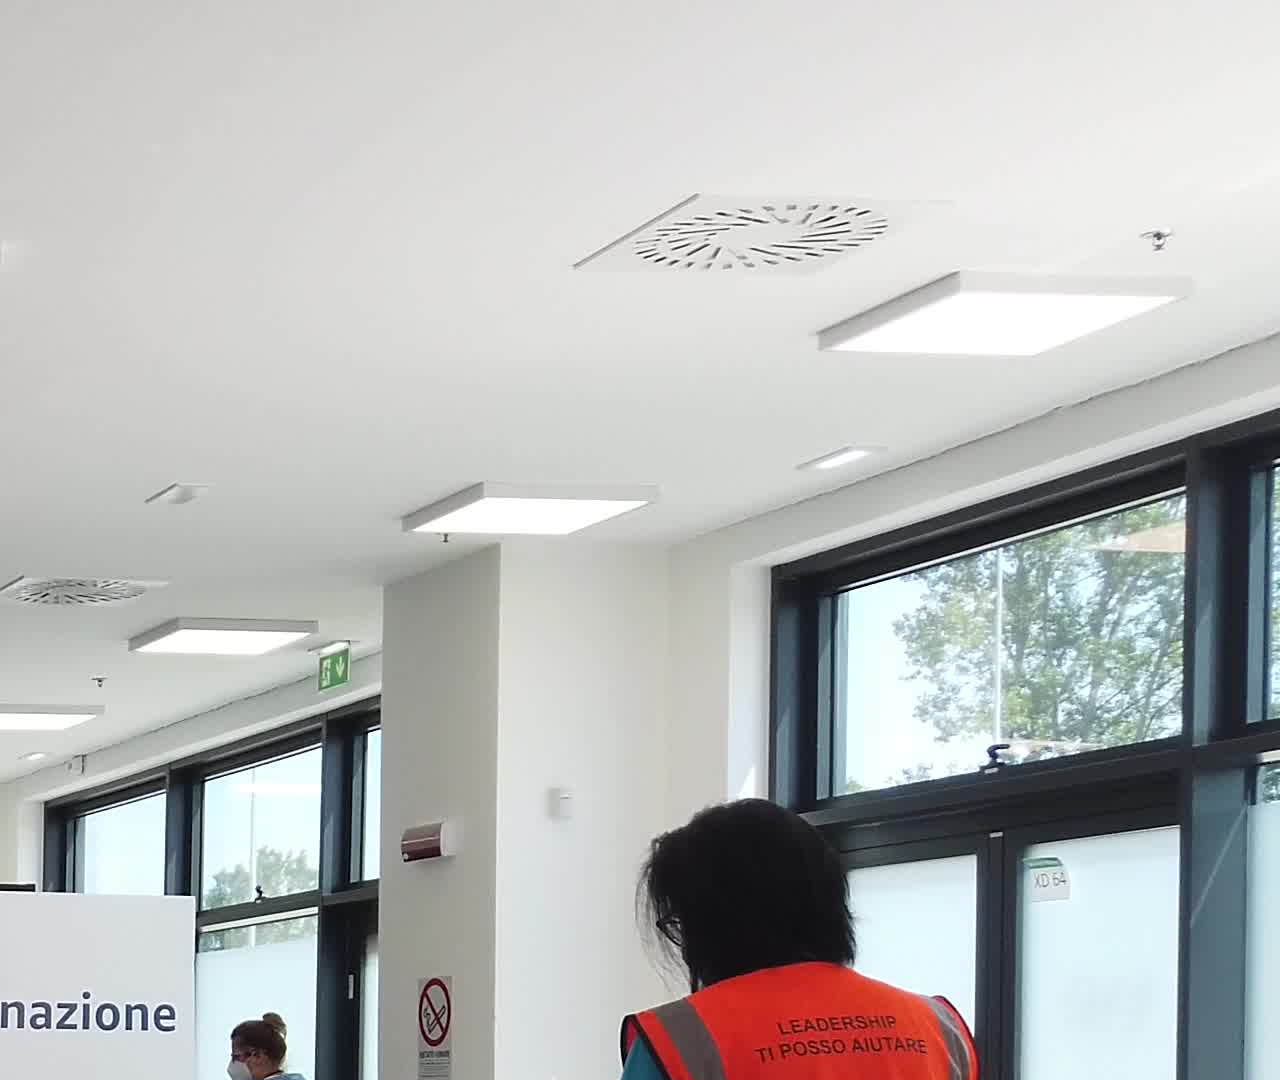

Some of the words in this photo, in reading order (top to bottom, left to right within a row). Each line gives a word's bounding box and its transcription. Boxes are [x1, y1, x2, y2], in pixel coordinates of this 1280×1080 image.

[776, 1015, 897, 1036] LEADERSHIP
[753, 1047, 775, 1064] TI
[780, 1039, 846, 1058] POSSO
[851, 1037, 928, 1055] AIUTARE
